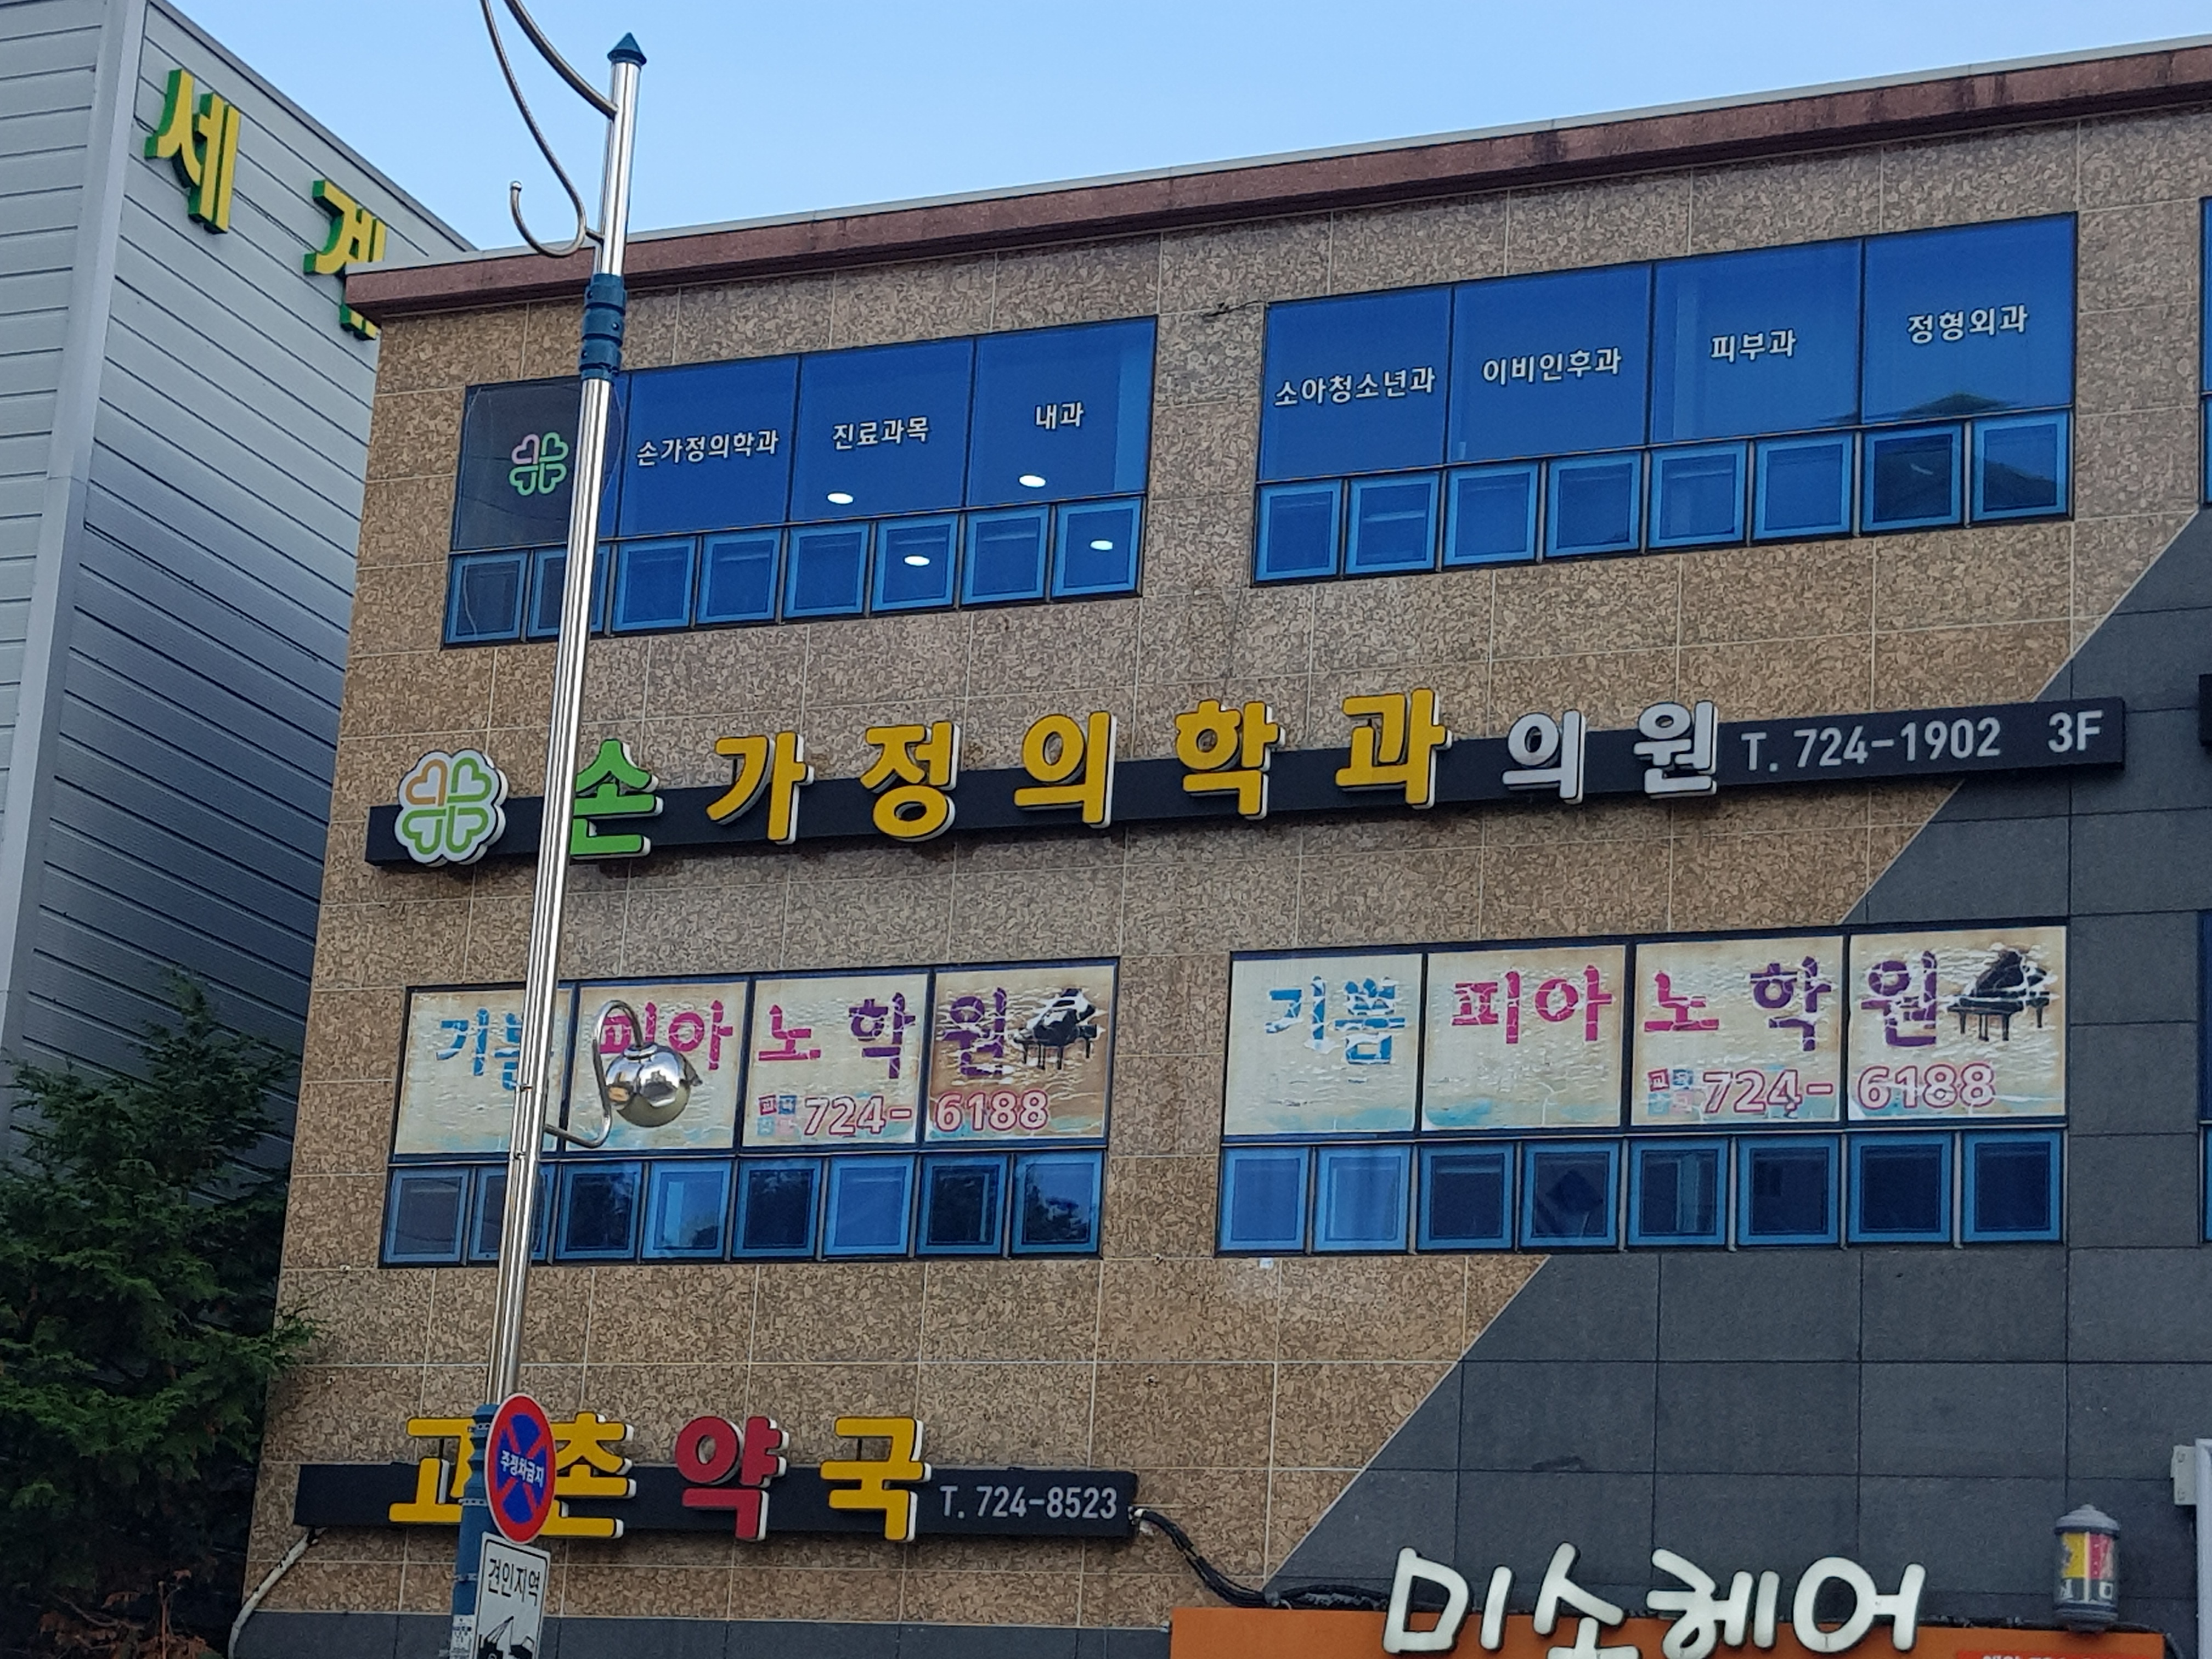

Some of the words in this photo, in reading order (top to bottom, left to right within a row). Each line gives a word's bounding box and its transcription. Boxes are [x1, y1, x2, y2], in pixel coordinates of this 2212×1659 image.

[1906, 304, 2029, 343] 정형외과
[1711, 329, 1798, 363] 피부과
[1483, 348, 1622, 385] 이비인후과
[1274, 367, 1435, 407] 소아청소년과
[832, 417, 929, 451] 진료과목
[1035, 402, 1085, 430] 내과
[636, 430, 779, 467] 손가정의학과
[1741, 731, 1779, 772] T.
[1793, 716, 2001, 768] 724-1902
[2047, 710, 2103, 753] 3F
[1265, 976, 1406, 1064] 기쁨
[500, 1449, 544, 1488] 주정차금지
[940, 1486, 965, 1520] T.
[977, 1486, 1118, 1520] 724-8523
[488, 1558, 540, 1606] 견인지역
